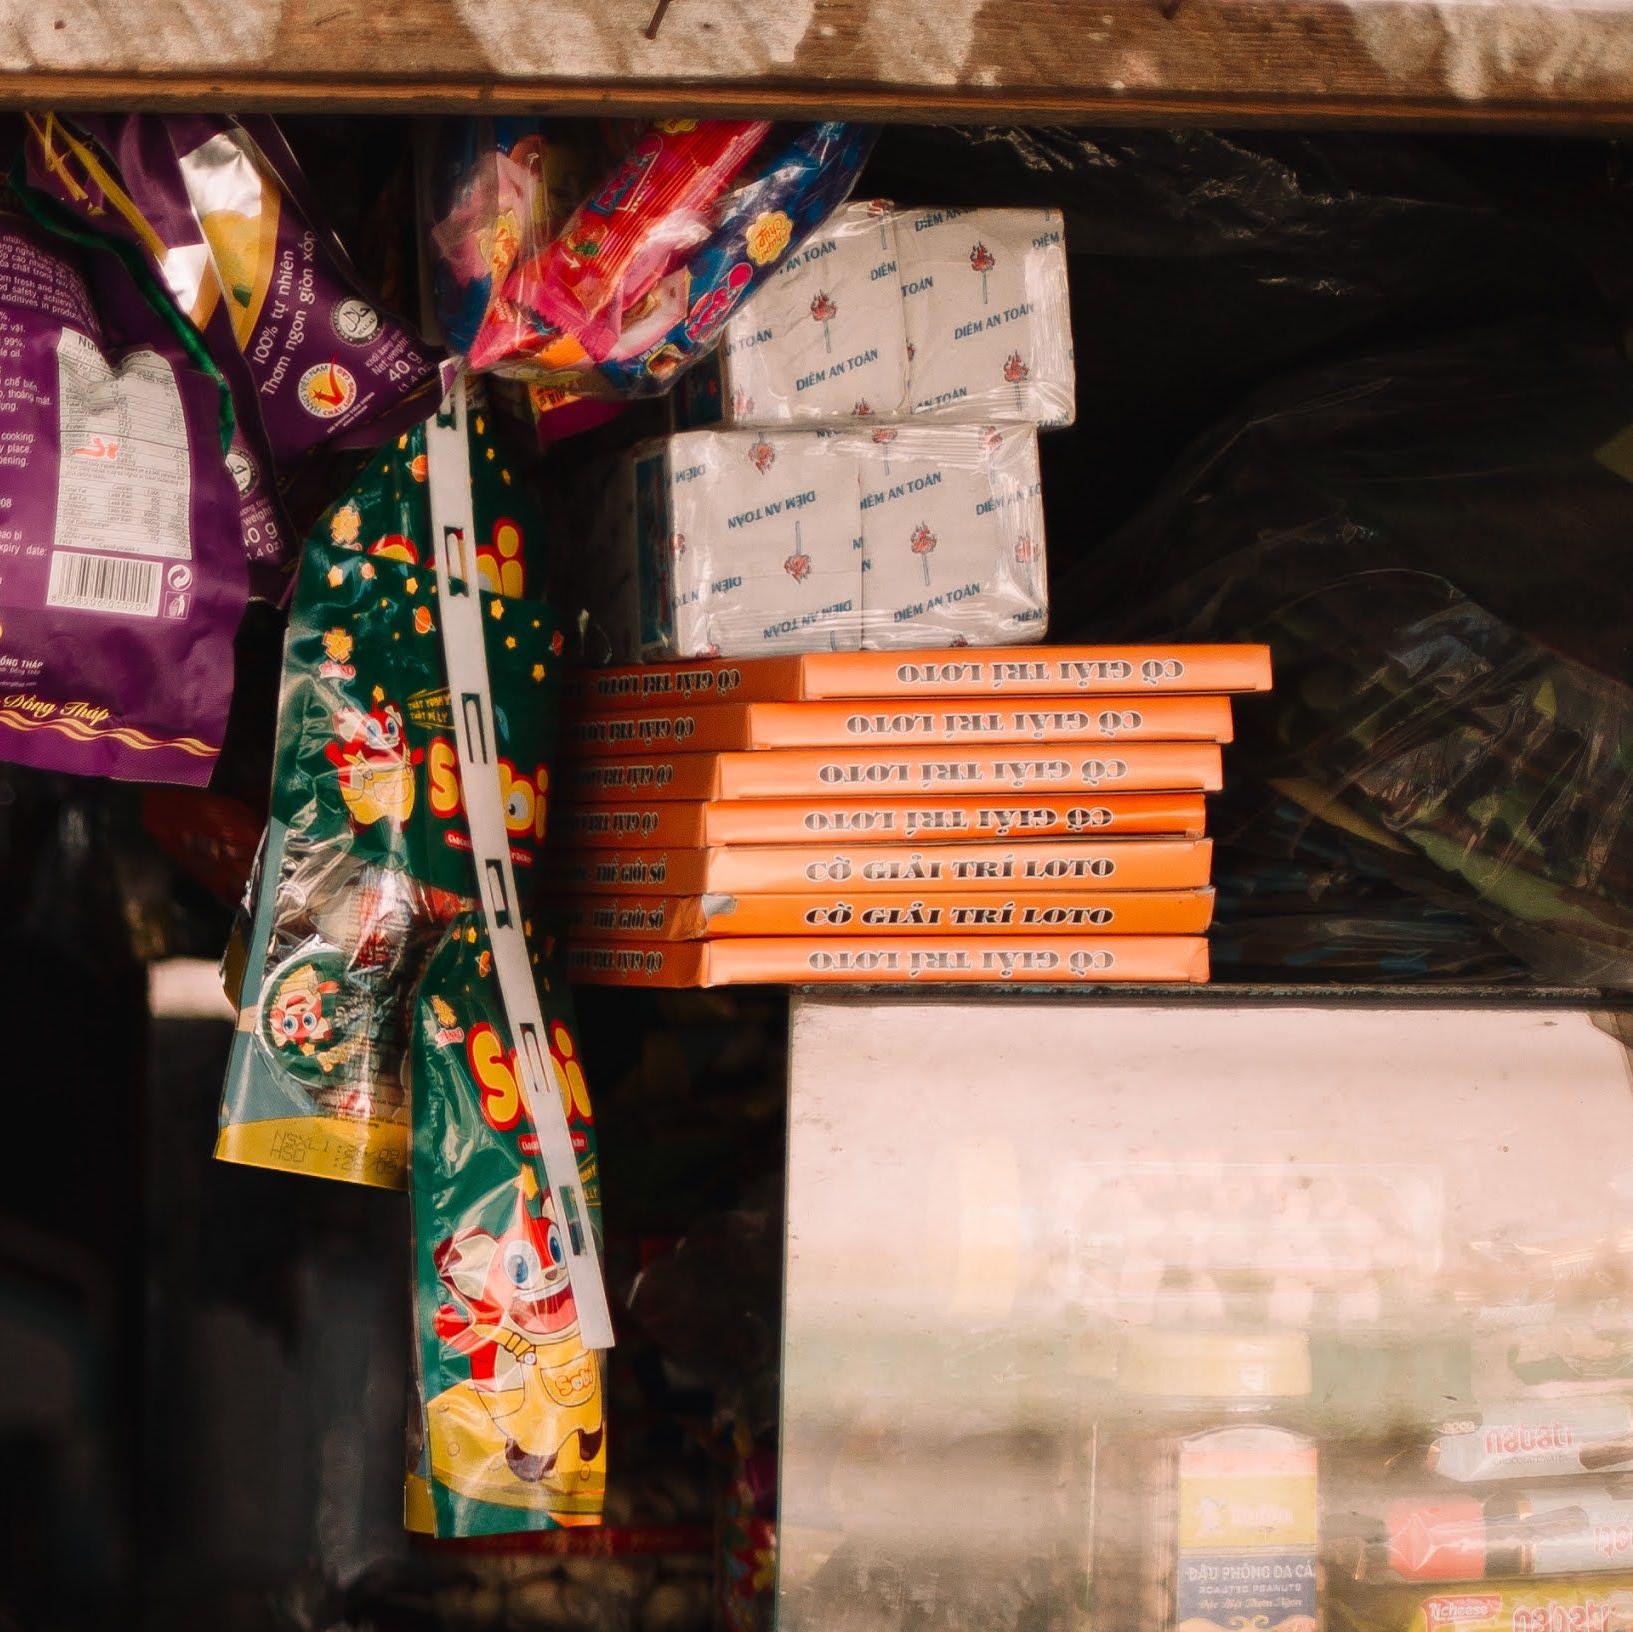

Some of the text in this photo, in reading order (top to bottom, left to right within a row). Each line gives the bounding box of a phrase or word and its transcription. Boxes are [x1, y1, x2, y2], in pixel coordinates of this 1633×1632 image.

[286, 309, 307, 351] ngon
[253, 325, 278, 365] 100%
[387, 360, 411, 383] 40
[897, 662, 982, 683] LOTO
[992, 661, 1050, 688] TRÍ
[847, 714, 934, 735] LOTO
[945, 713, 1003, 739] TRÍ
[820, 763, 909, 784] LOTO
[920, 763, 983, 788] TRÍ
[803, 810, 895, 831] LOTO
[904, 809, 967, 836] TRÍ
[950, 854, 1015, 879] TRÍ
[1023, 858, 1115, 878] LOTO
[949, 902, 1015, 925] TRÍ
[1019, 907, 1114, 925] LOTO
[808, 951, 900, 971] LOTO
[909, 950, 971, 977] TRÍ
